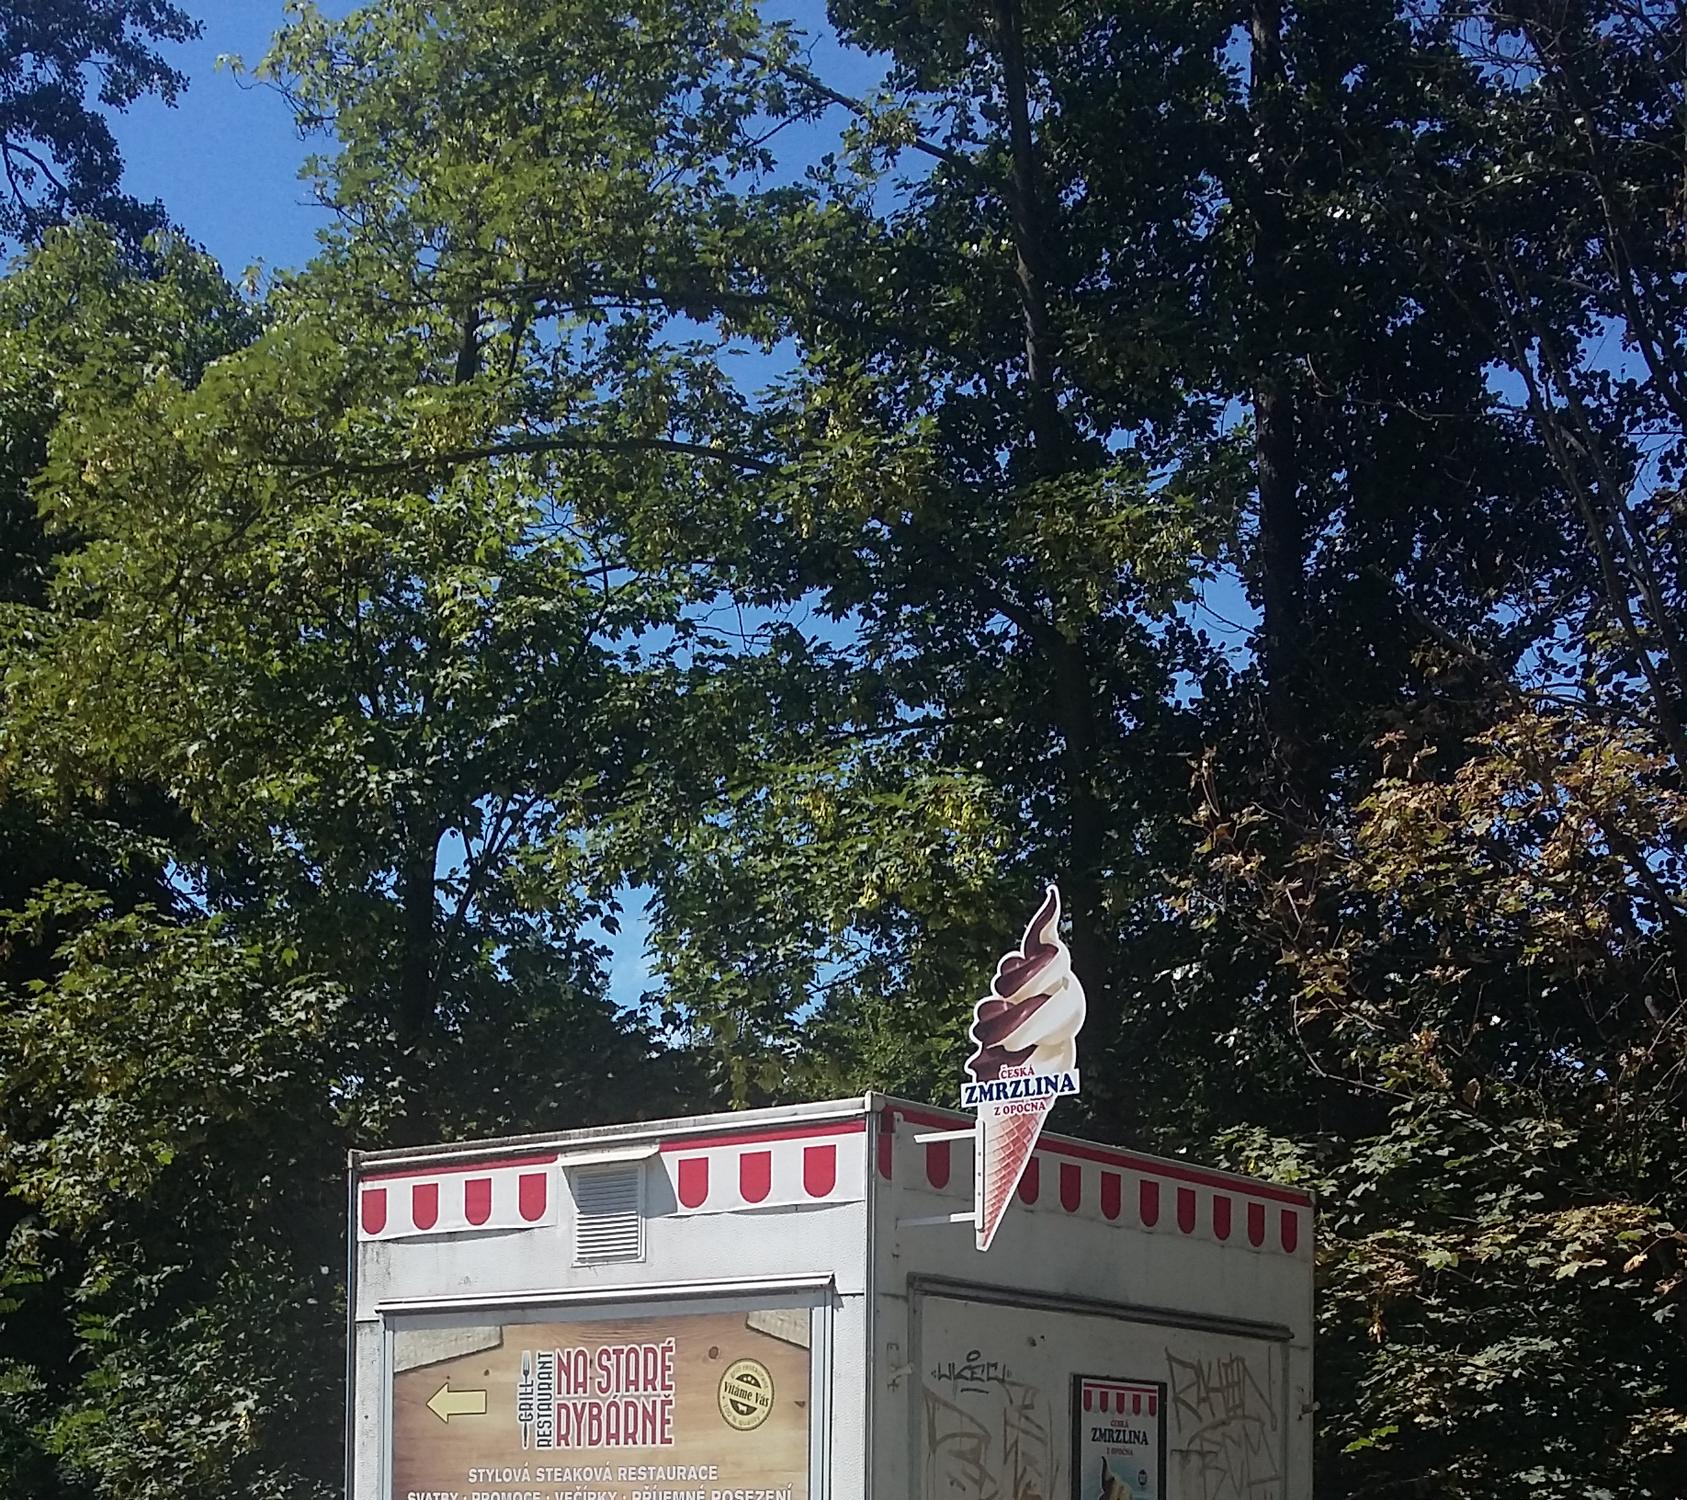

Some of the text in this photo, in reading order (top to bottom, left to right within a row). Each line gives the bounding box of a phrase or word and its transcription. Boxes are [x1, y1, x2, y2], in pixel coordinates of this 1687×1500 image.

[1000, 1064, 1035, 1079] ČESKÁ
[964, 1073, 1076, 1105] ZMRZLINA
[993, 1107, 1001, 1116] Z
[556, 1349, 588, 1395] NA
[597, 1339, 674, 1394] STARÉ
[518, 1379, 534, 1423] GRILL
[536, 1352, 553, 1448] RESTAURANT
[755, 1392, 770, 1408] Vás
[556, 1394, 674, 1448] RYBÁRNĚ
[1091, 1427, 1149, 1446] ZMRZLINA
[467, 1461, 719, 1483] STYLOVÁ STEAKOVÁ RESTAURACE
